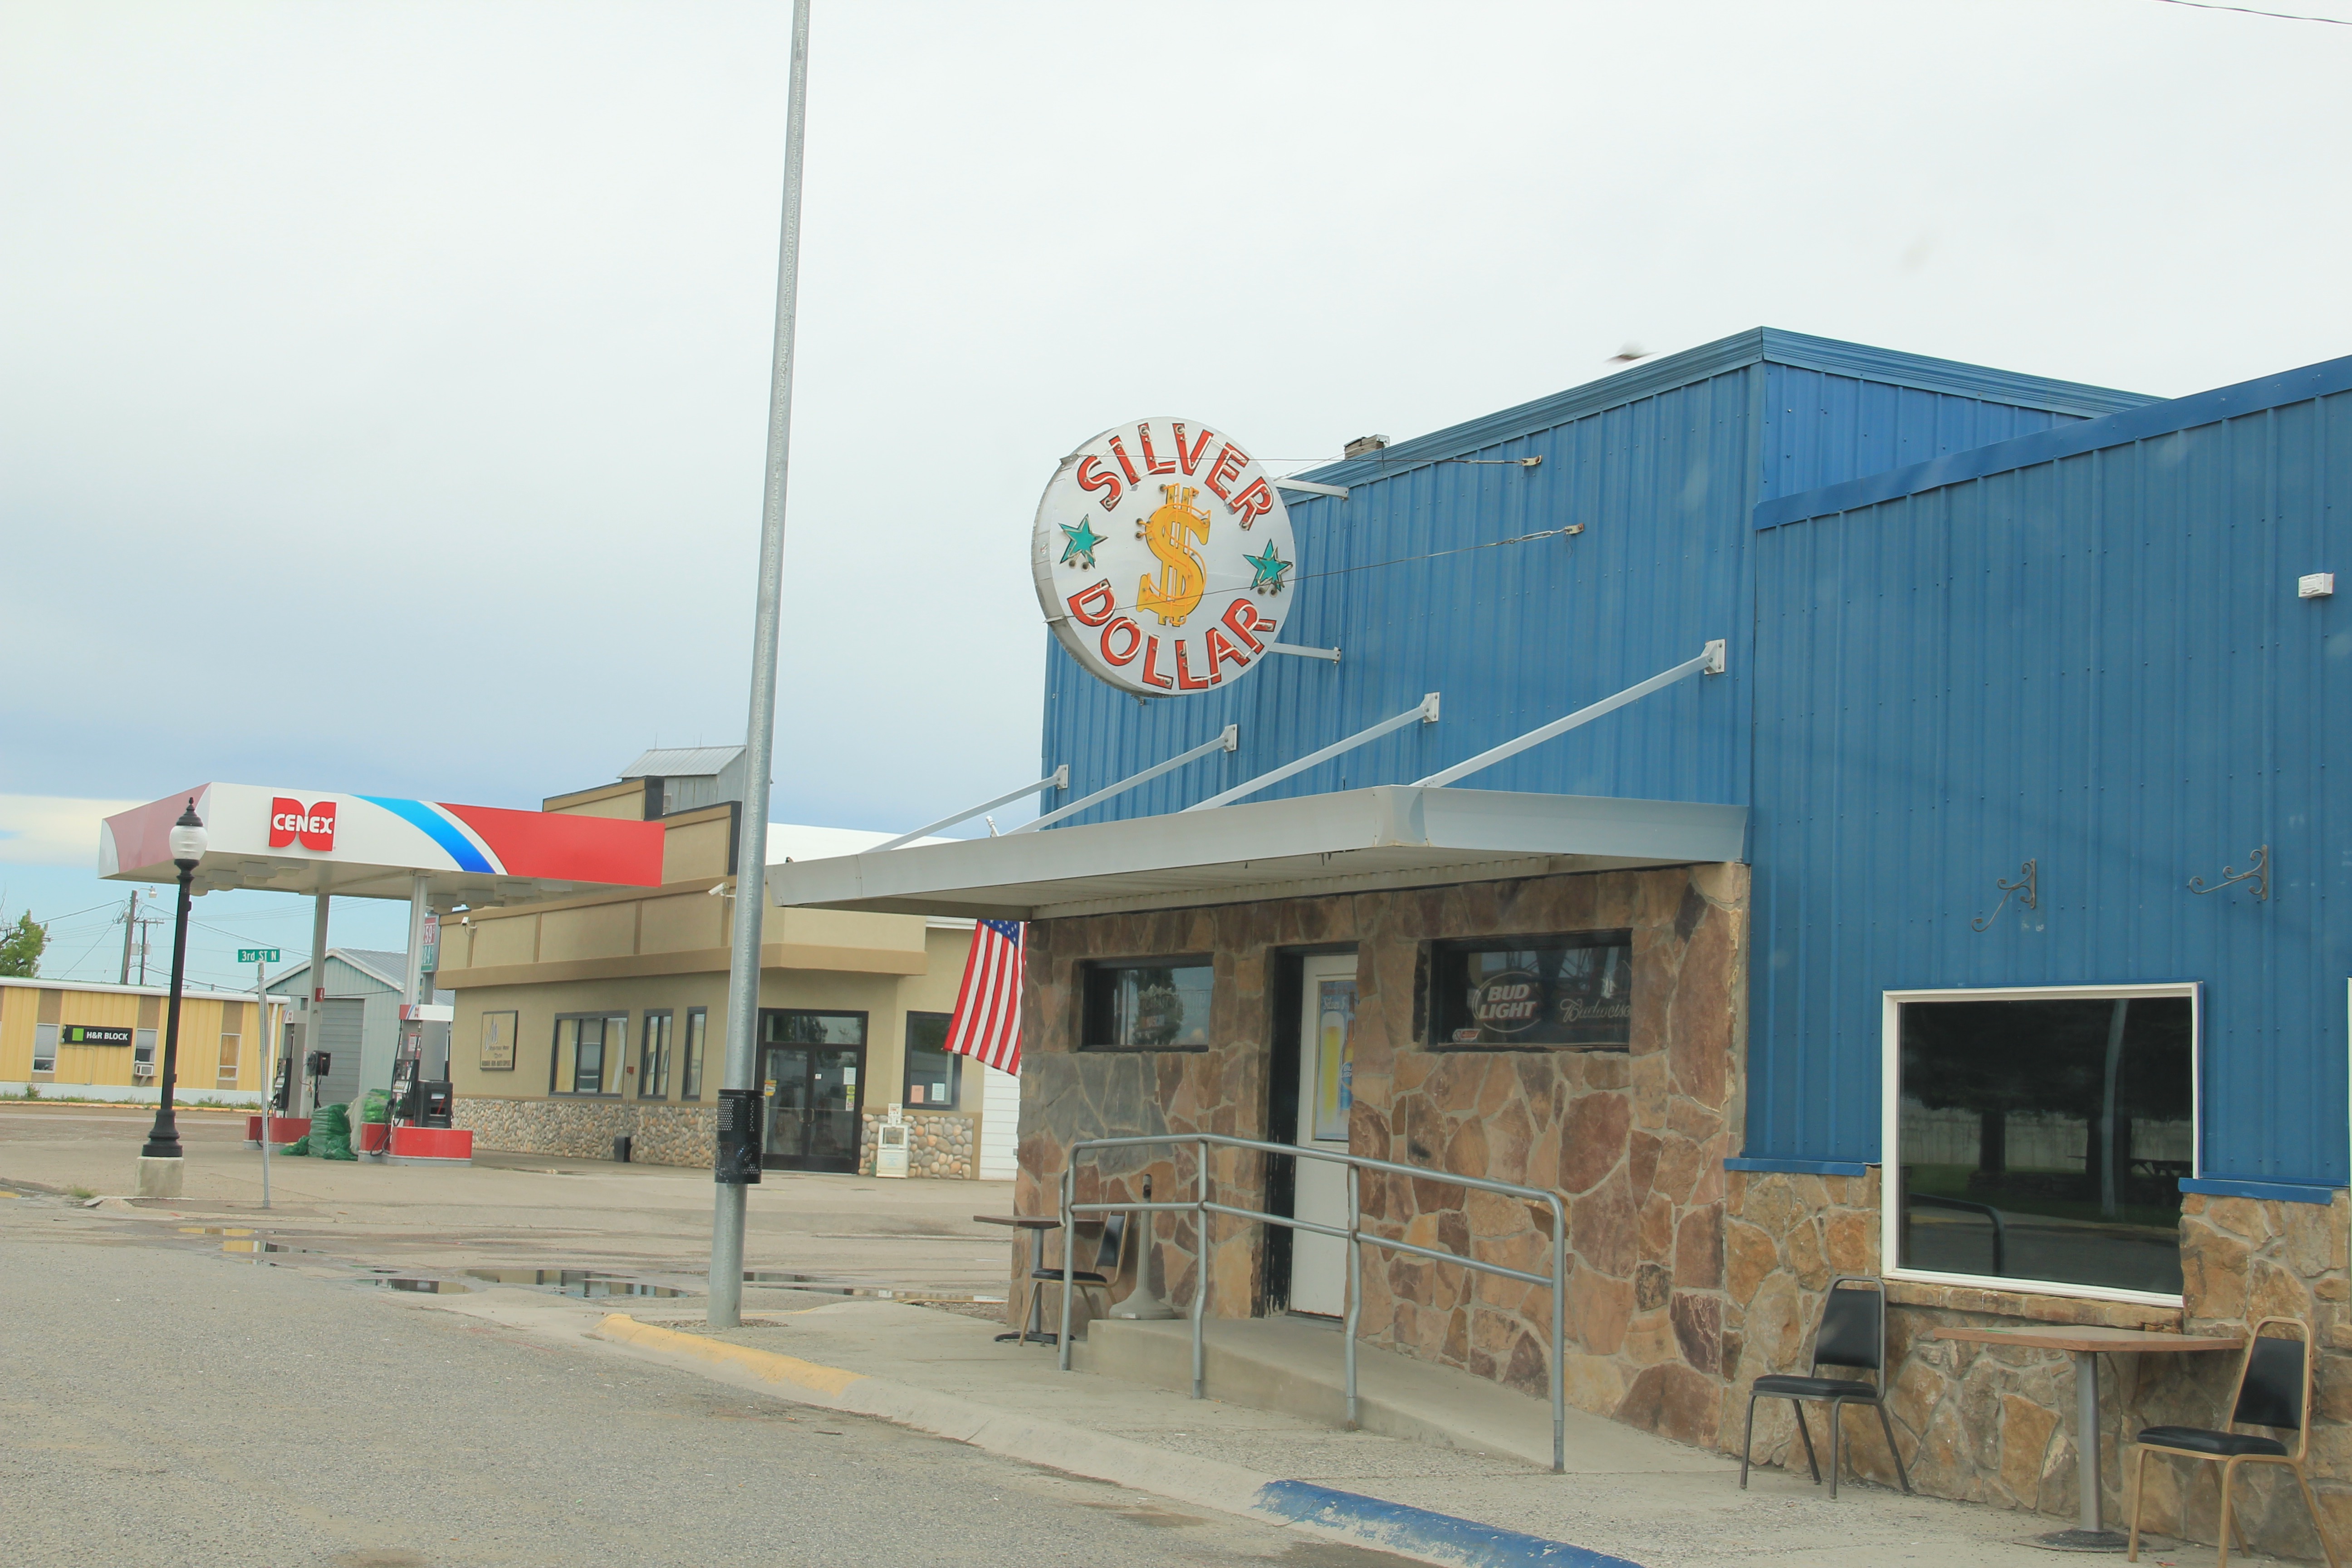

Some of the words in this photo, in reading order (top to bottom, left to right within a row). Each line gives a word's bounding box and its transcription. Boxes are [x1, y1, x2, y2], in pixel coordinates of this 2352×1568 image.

[1077, 422, 1274, 530] SILVER
[1067, 578, 1277, 690] DOLLAR
[273, 813, 333, 834] CENEX
[242, 951, 255, 961] 3rd
[259, 951, 268, 960] ST
[271, 951, 277, 960] N
[319, 989, 323, 1000] 4
[1487, 984, 1531, 1003] BUD
[1479, 1001, 1537, 1021] LIGHT
[1560, 999, 1631, 1022] Budweise
[86, 1031, 103, 1039] H&R
[104, 1032, 128, 1040] BLOCK
